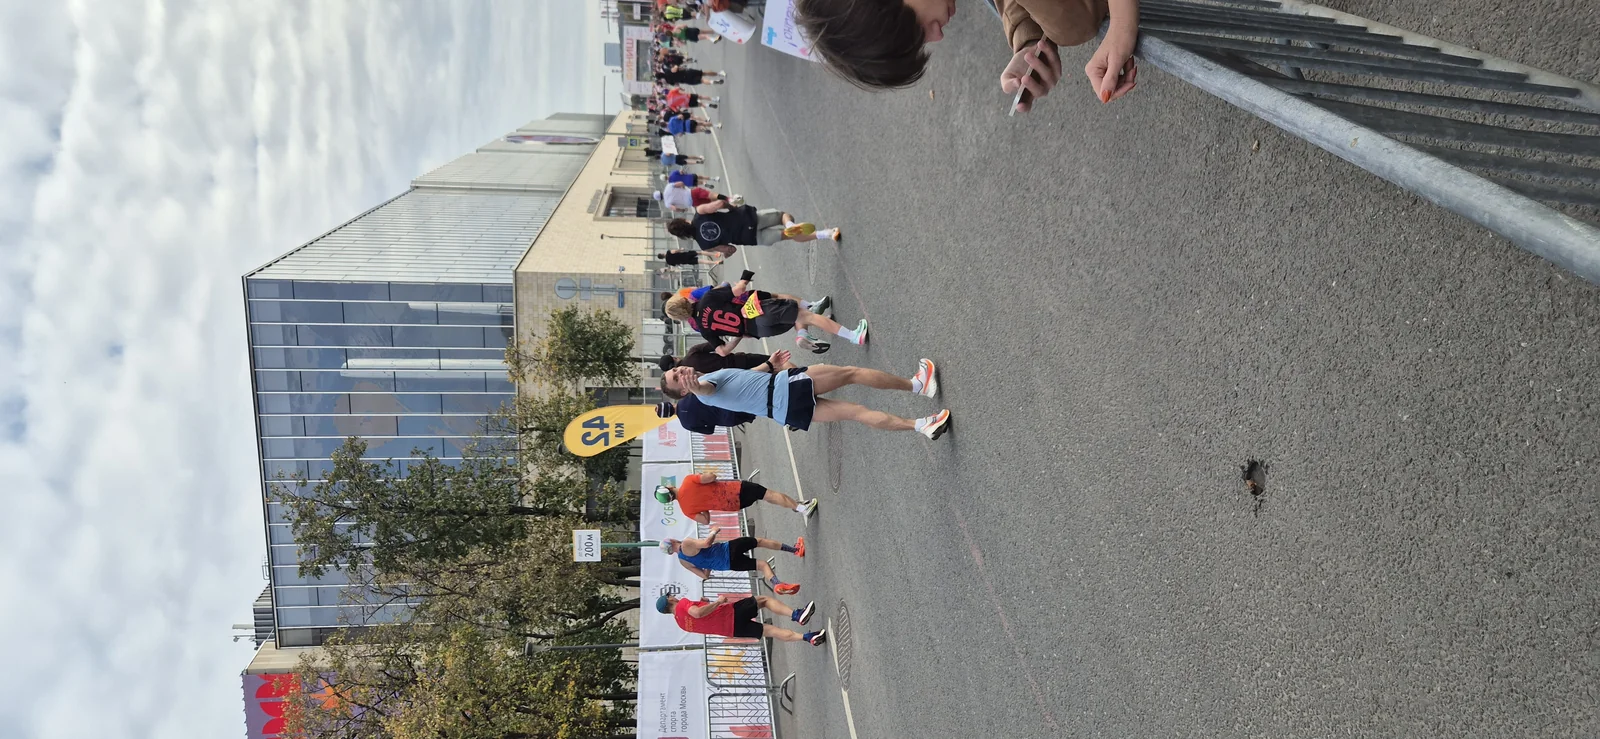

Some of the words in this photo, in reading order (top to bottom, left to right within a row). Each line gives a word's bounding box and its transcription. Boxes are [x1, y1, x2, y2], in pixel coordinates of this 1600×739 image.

[711, 310, 740, 333] 16
[584, 542, 593, 557] 200
[659, 693, 667, 733] Департамент
[670, 711, 678, 732] спорта
